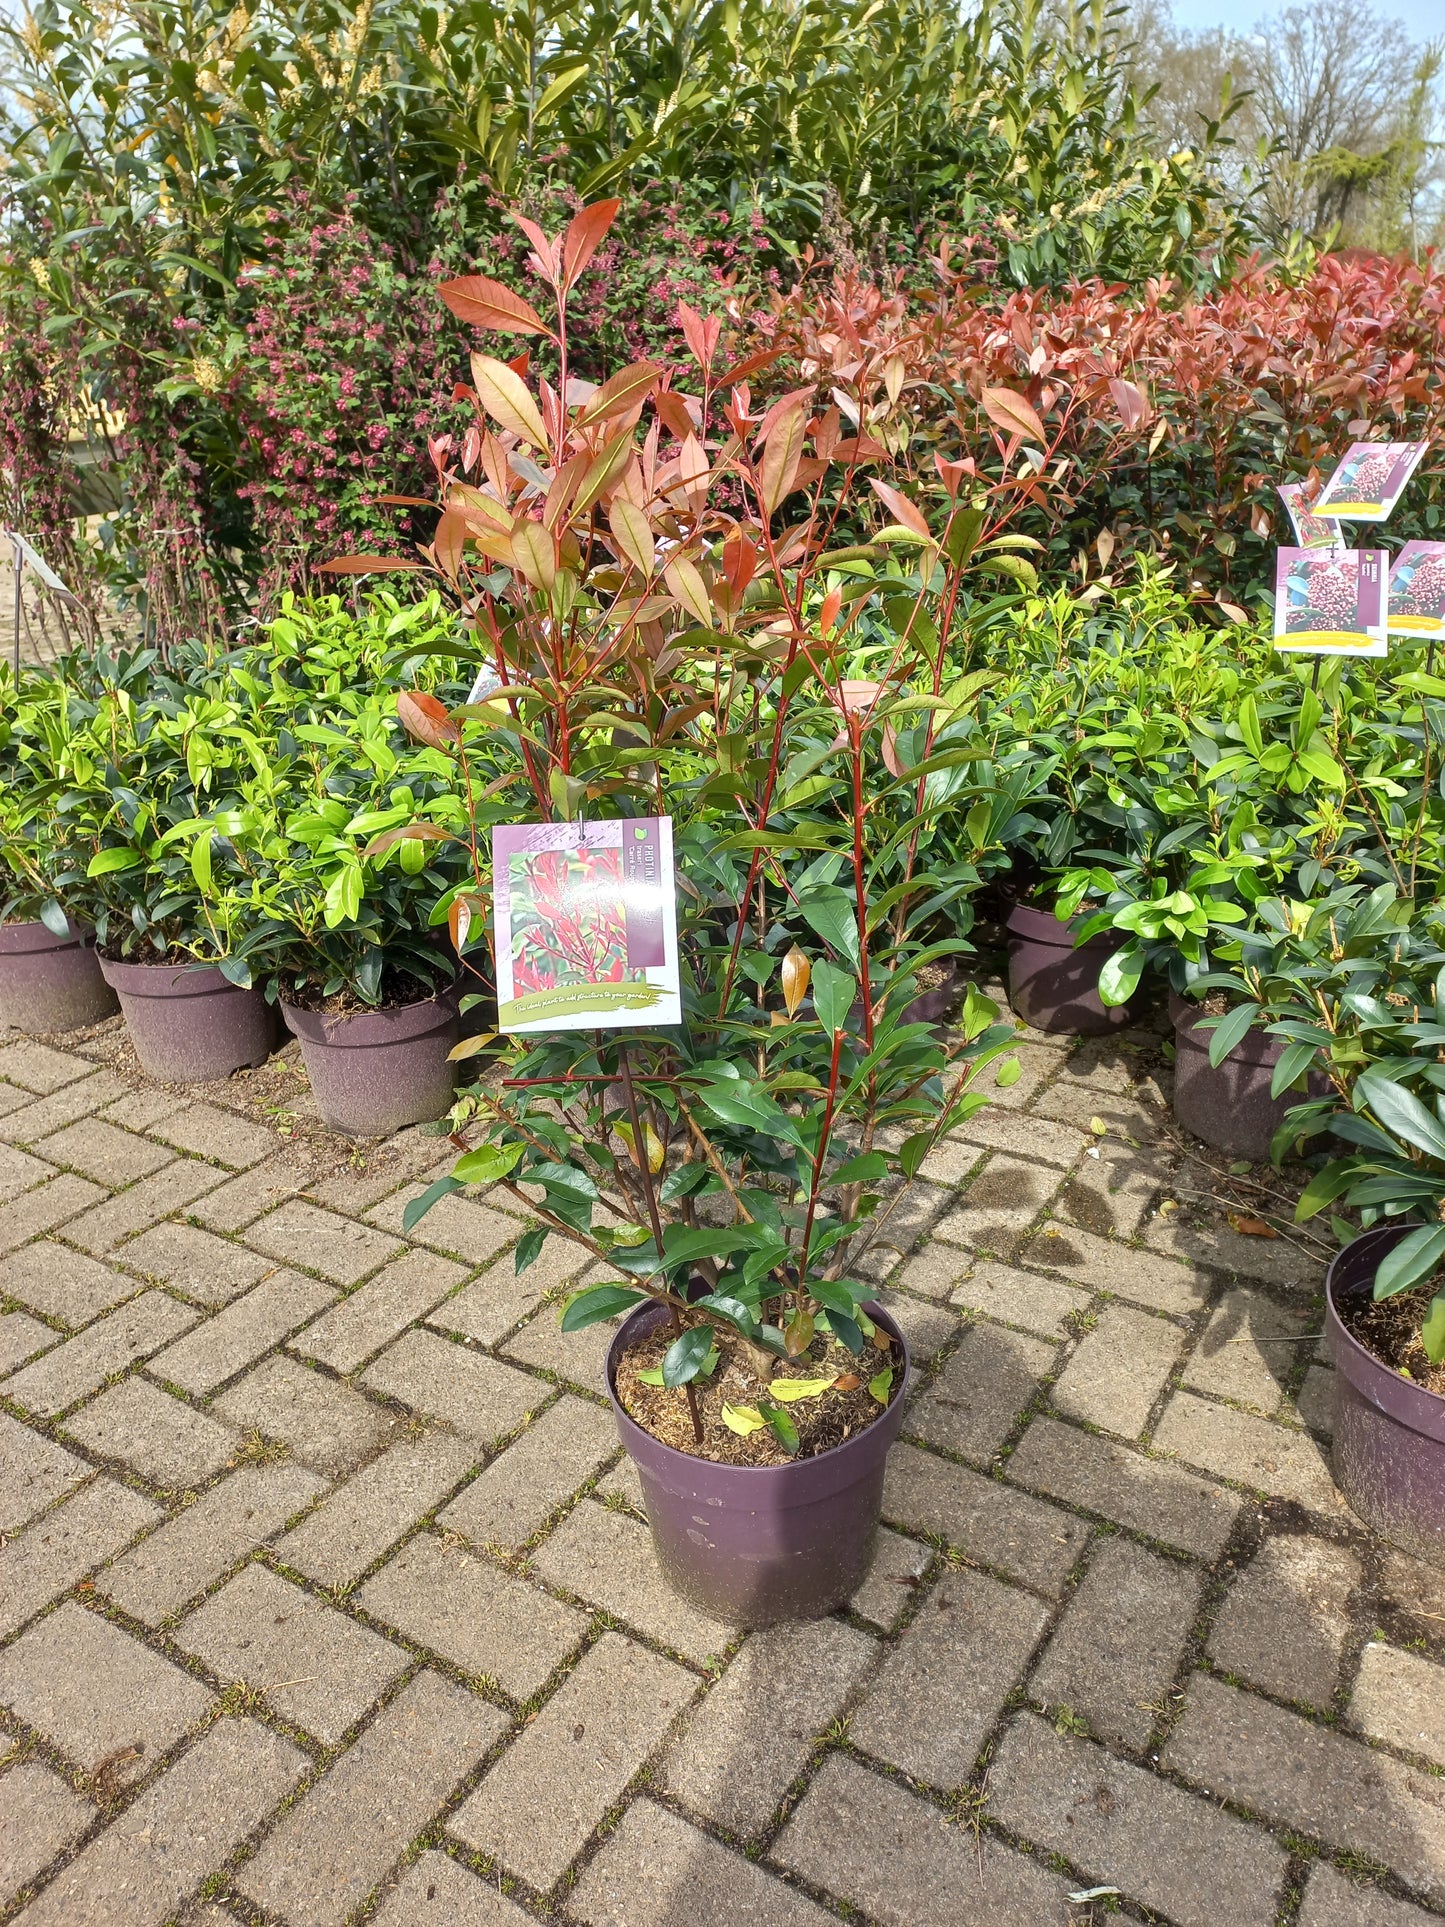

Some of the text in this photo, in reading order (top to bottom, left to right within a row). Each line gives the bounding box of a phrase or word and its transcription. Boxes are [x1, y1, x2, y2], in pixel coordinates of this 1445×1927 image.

[566, 993, 577, 1001] add
[577, 992, 603, 1001] structure
[611, 993, 626, 1001] your
